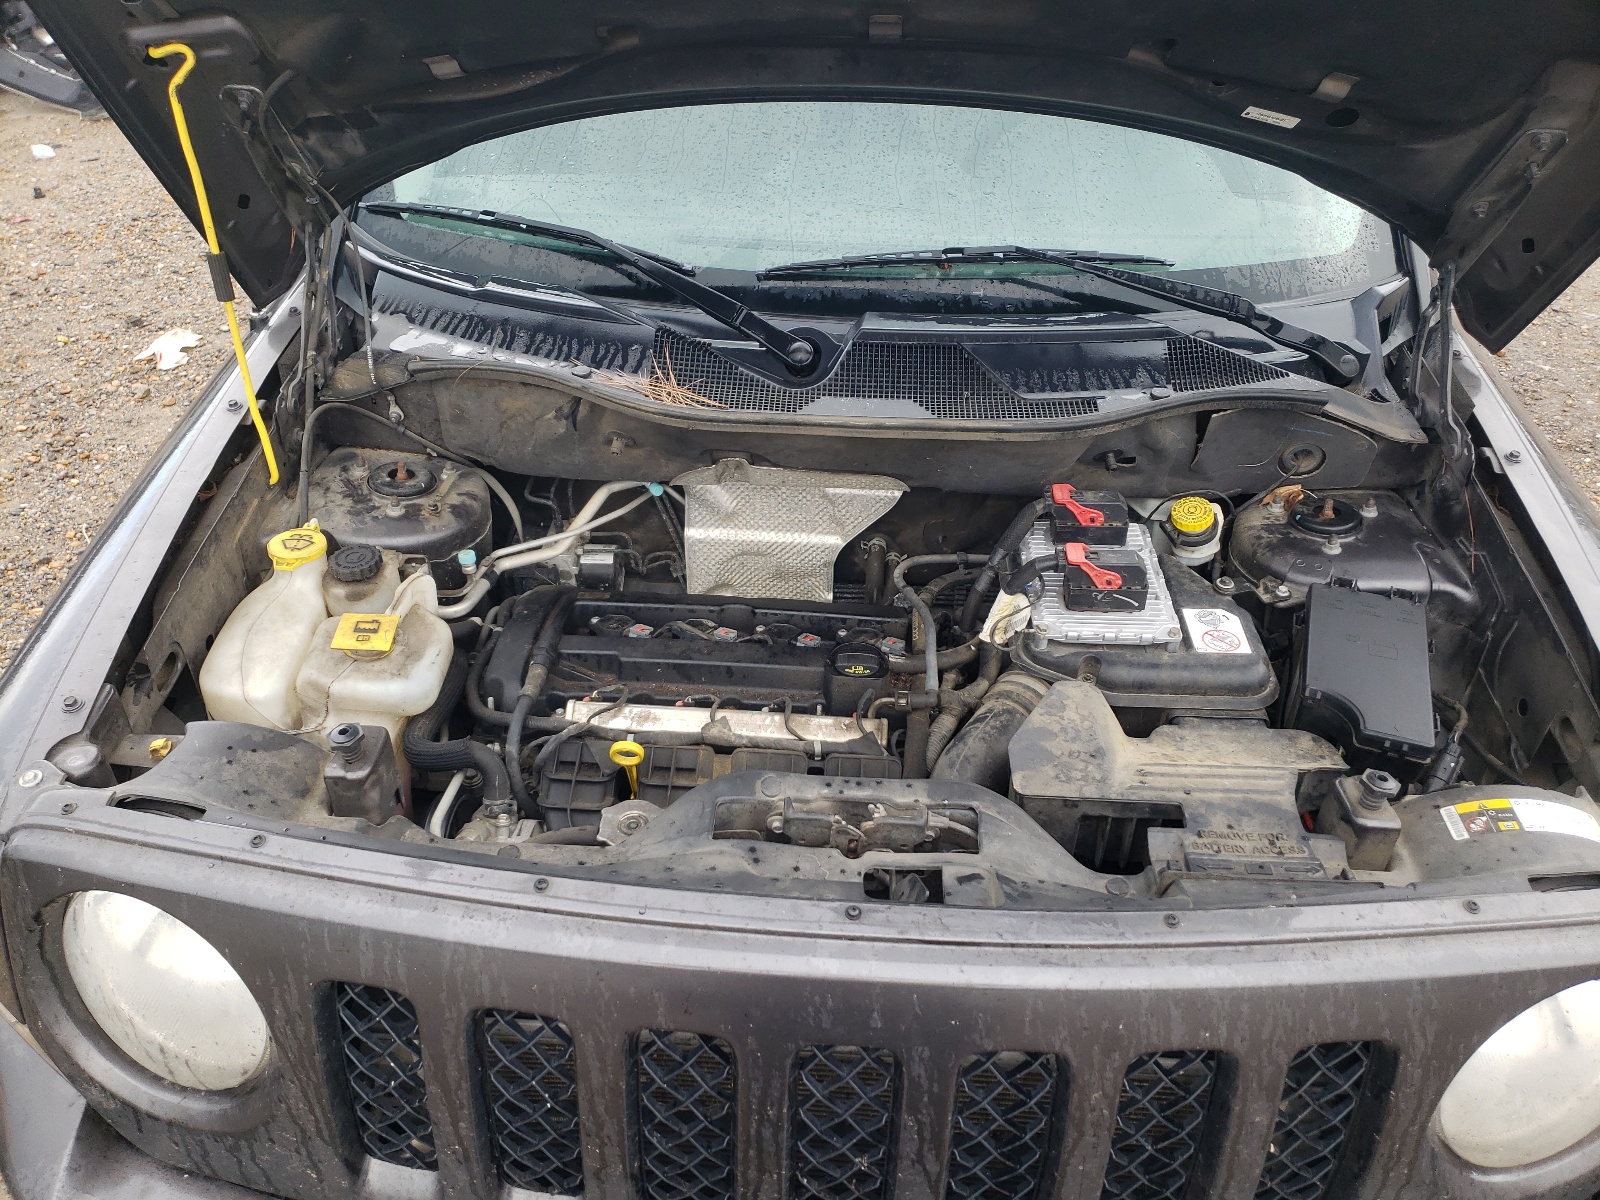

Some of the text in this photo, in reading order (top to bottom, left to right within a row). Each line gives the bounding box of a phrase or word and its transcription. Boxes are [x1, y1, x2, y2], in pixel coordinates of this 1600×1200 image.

[1198, 830, 1288, 842] REMOVE FOR
[1192, 842, 1307, 855] BATTERY ACCESS
